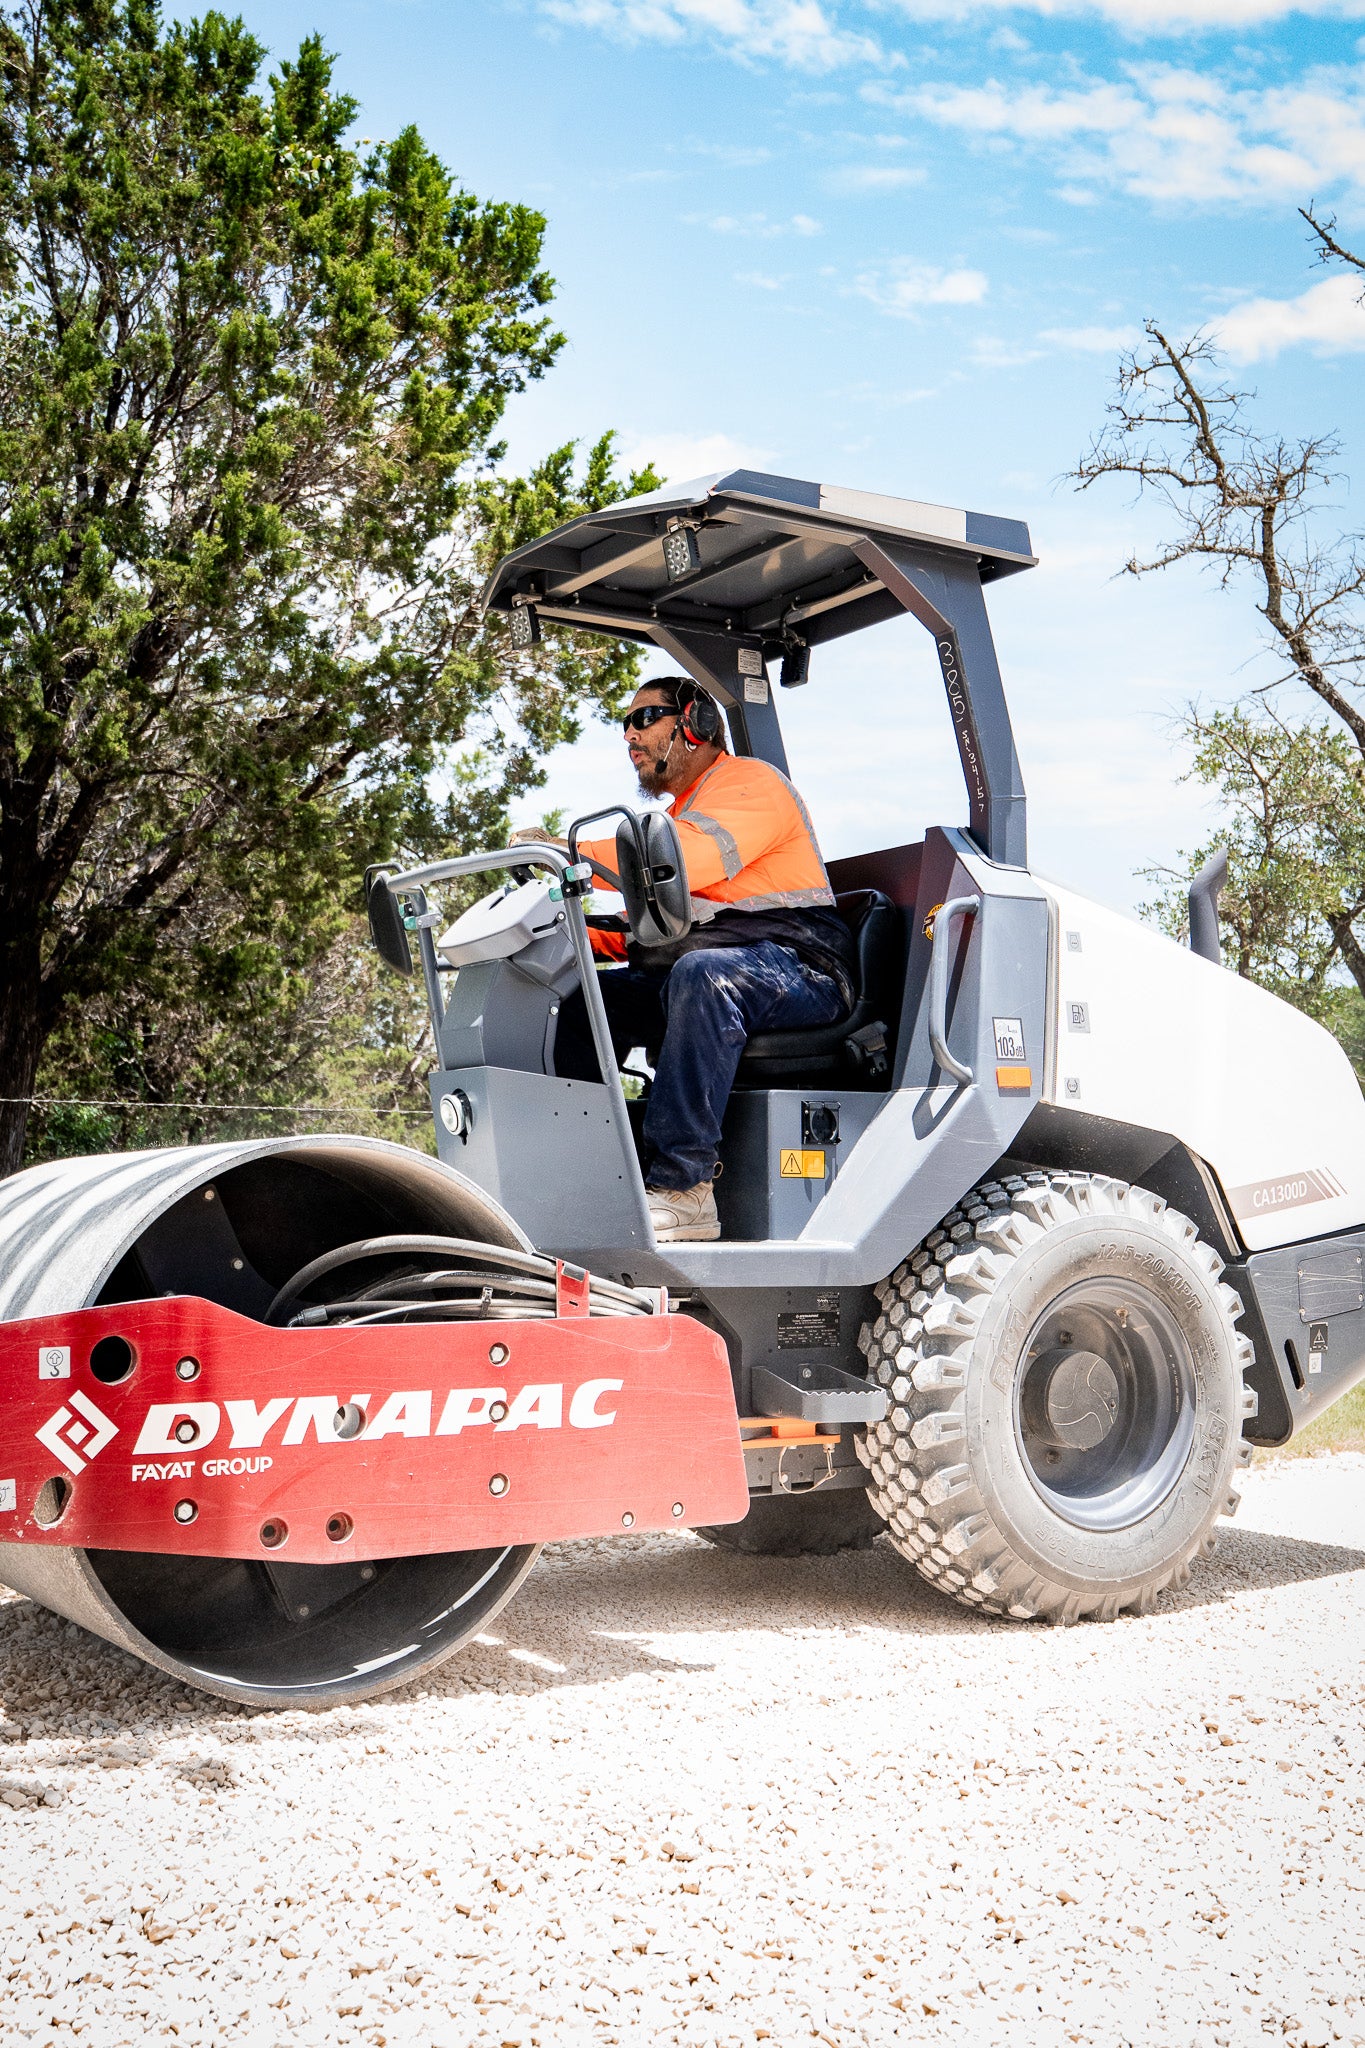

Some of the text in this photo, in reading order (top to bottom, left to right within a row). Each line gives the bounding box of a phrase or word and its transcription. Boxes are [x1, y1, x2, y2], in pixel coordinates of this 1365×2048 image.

[997, 1036, 1015, 1056] 103
[1252, 1180, 1308, 1208] CA1300D
[131, 1378, 624, 1455] DYNAPAC
[131, 1456, 273, 1482] FAYAT GROUP
